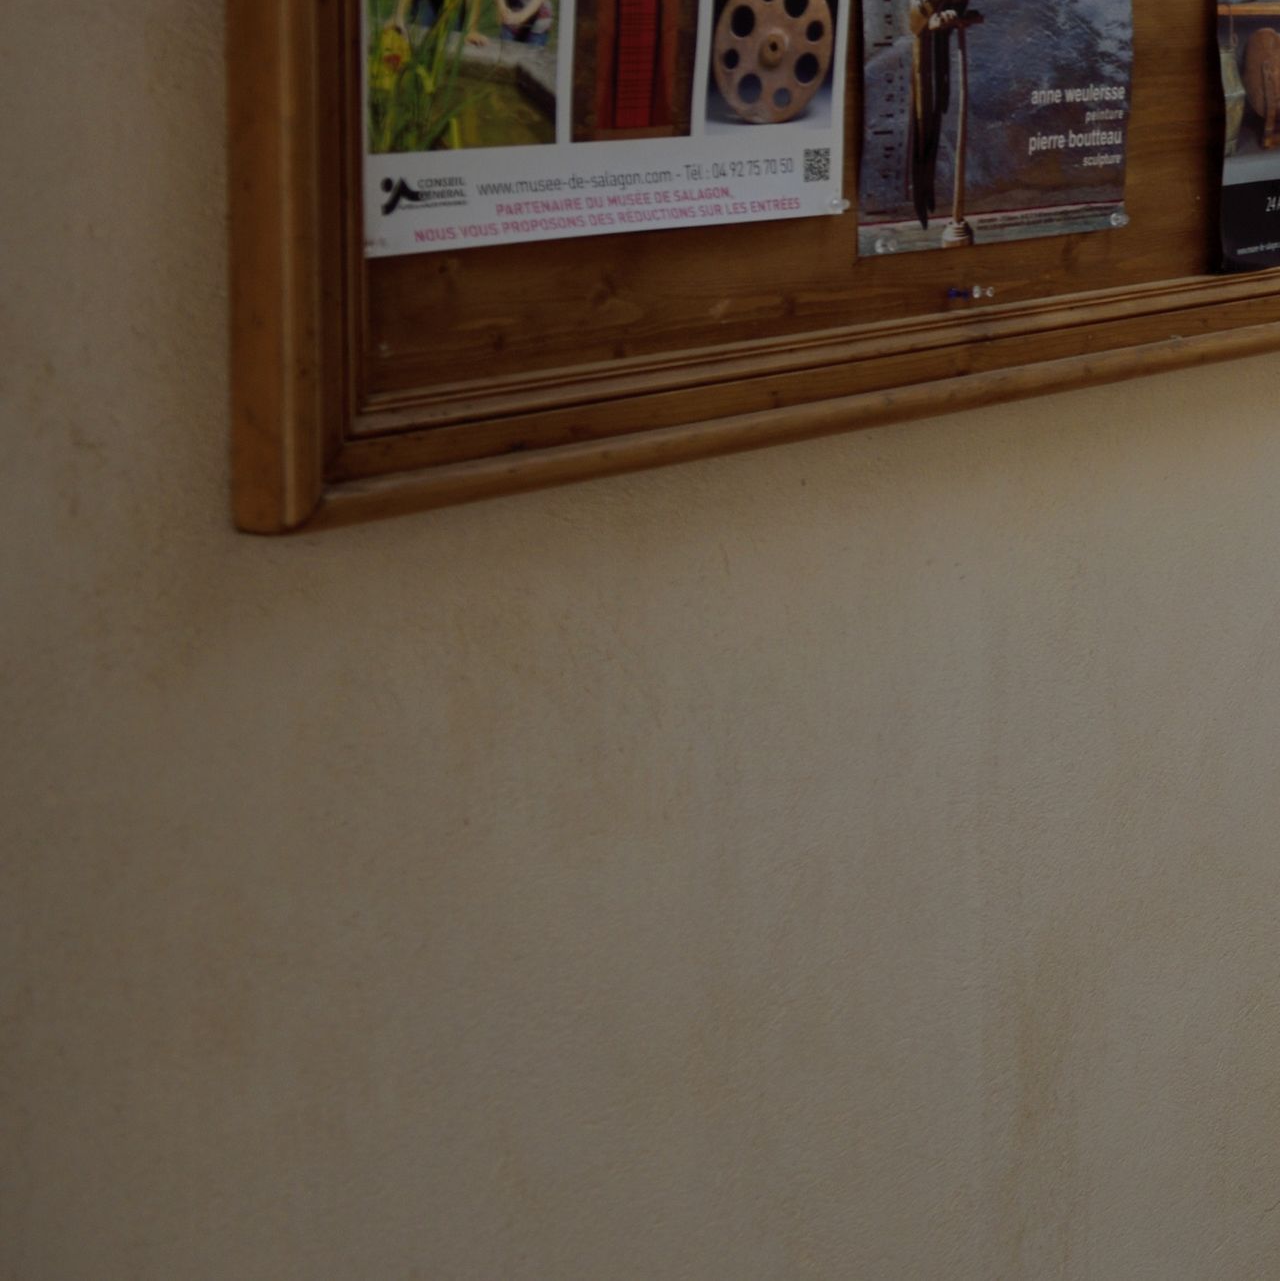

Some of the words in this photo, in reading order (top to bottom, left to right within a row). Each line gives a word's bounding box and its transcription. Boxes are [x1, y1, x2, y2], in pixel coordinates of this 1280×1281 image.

[1031, 88, 1062, 105] anne
[1065, 83, 1126, 103] weulersse
[1085, 108, 1123, 123] peinture
[1028, 133, 1065, 155] pierre
[1068, 129, 1123, 148] boutteau
[1083, 153, 1122, 169] sculpture
[417, 176, 466, 190] CONSEIL
[476, 169, 672, 197] www.musee-de-salagon.com
[712, 162, 726, 180] 04
[729, 160, 744, 178] 92
[746, 159, 761, 177] 75
[763, 158, 777, 175] 70
[779, 157, 795, 174] 50
[496, 197, 582, 216] PARTENAIRE
[585, 195, 604, 210] DU
[653, 189, 670, 204] DE
[675, 186, 734, 203] SALAGON,
[414, 227, 456, 243] NOUS
[460, 224, 499, 238] VOUS
[503, 217, 585, 235] PROPOSONS
[588, 212, 616, 227] DES
[700, 202, 722, 216] SUR
[726, 200, 747, 215] LES
[751, 196, 801, 213] ENTRÉES
